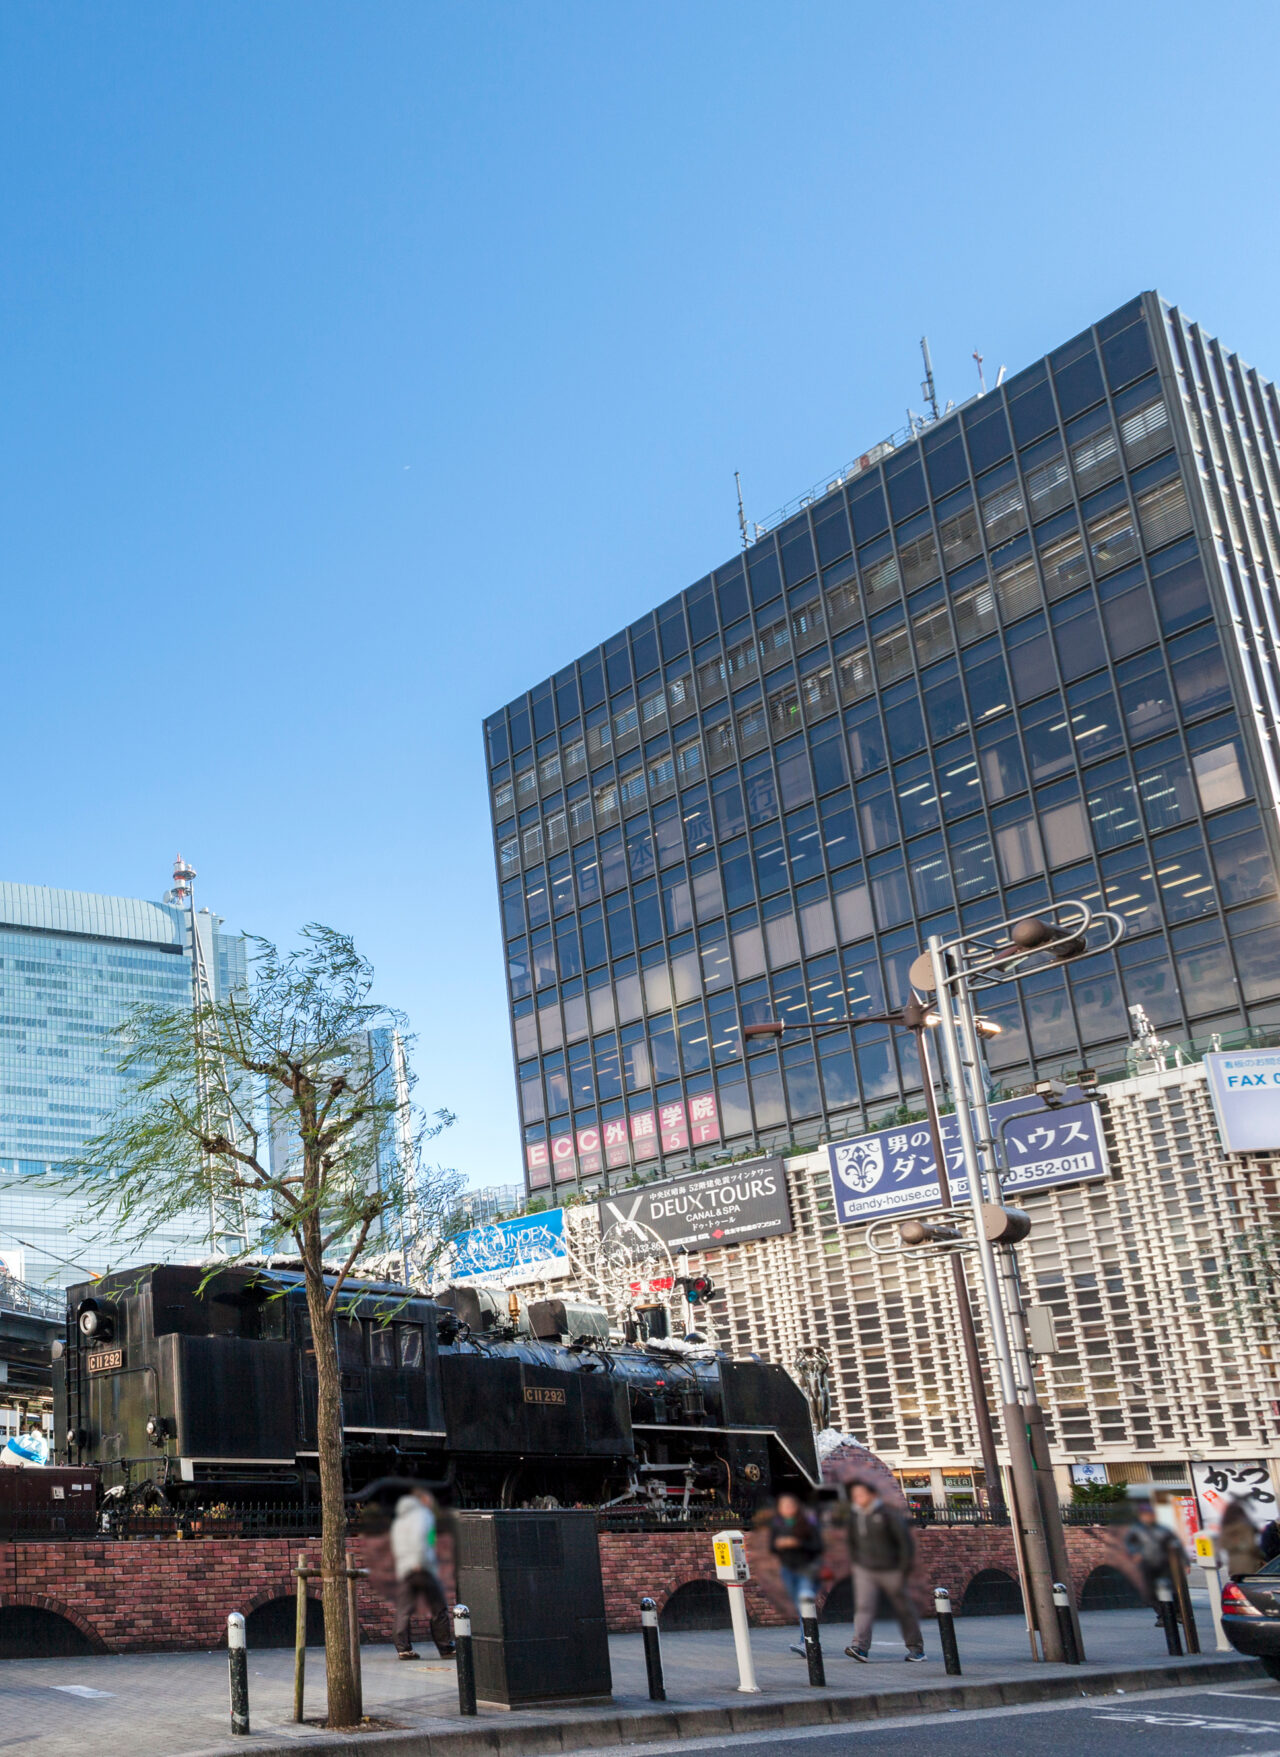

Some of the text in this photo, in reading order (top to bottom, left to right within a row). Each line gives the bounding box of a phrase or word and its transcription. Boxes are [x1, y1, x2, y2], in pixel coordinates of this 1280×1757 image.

[1227, 1073, 1267, 1087] FAX
[530, 1098, 714, 1165] ECC外語学院
[892, 1121, 1090, 1182] ダンデハウス
[650, 1176, 777, 1220] DEUX TOURS
[104, 1353, 120, 1367] 292
[544, 1390, 564, 1402] 292
